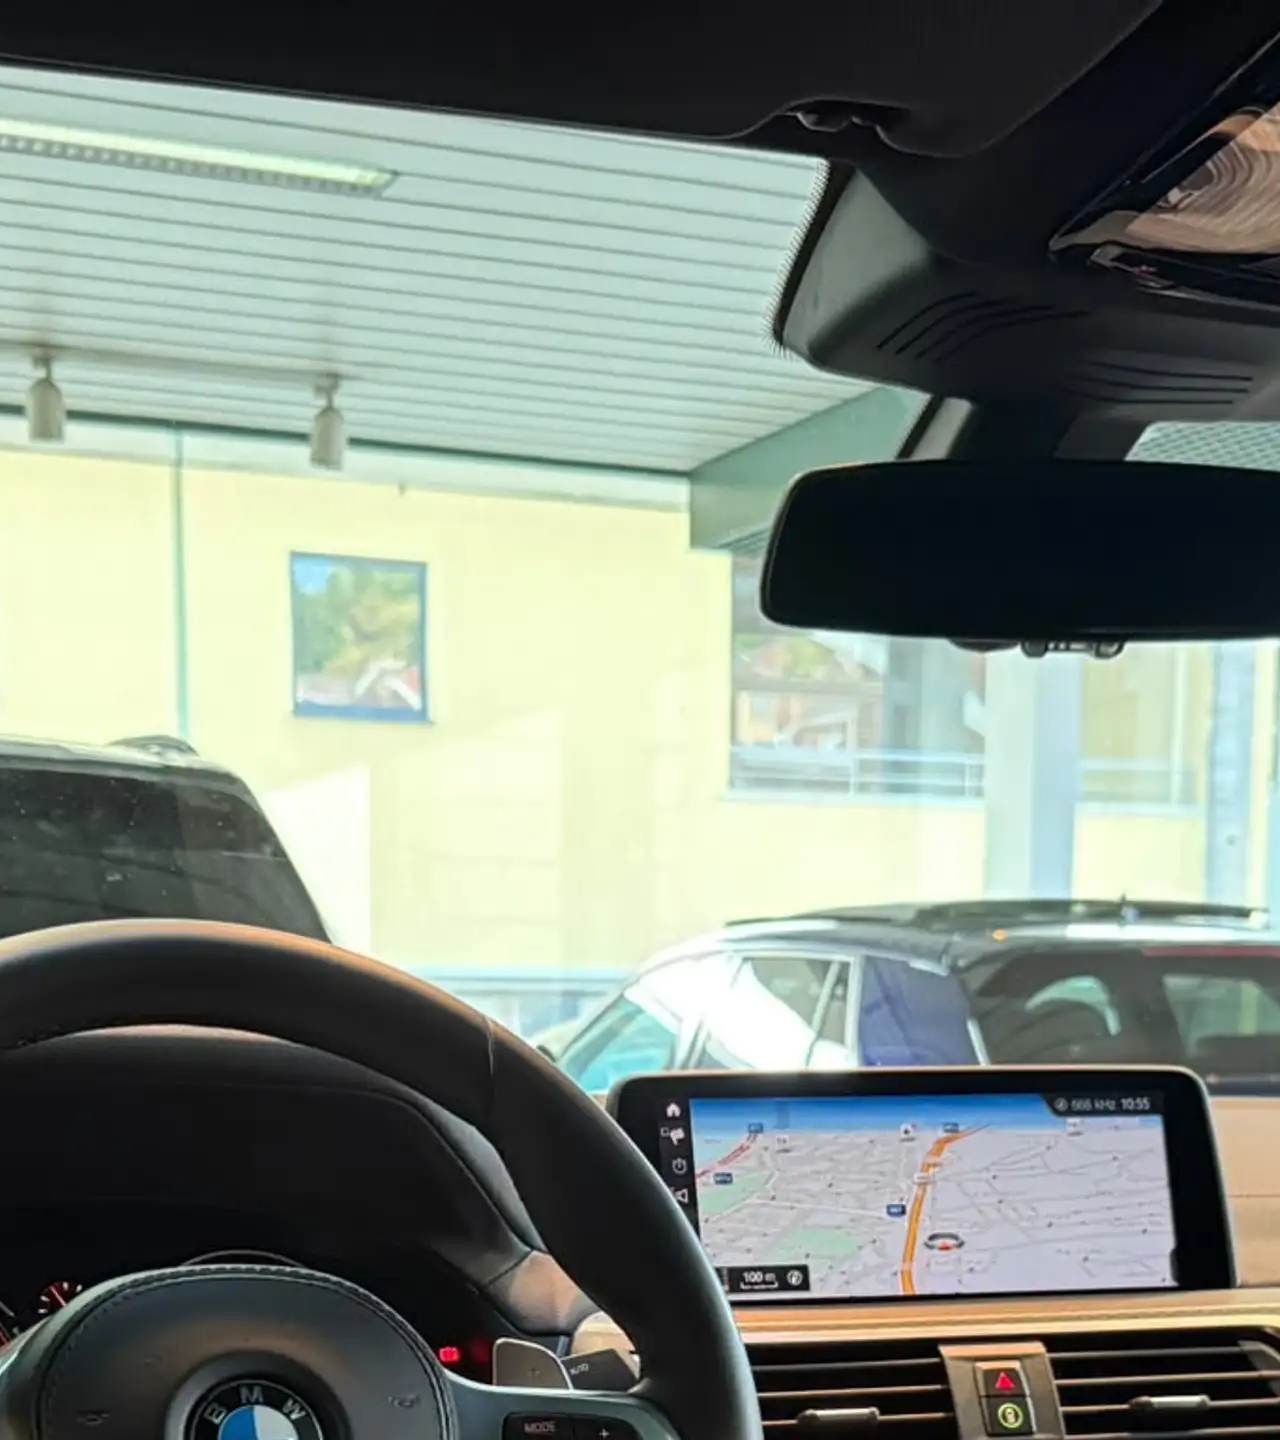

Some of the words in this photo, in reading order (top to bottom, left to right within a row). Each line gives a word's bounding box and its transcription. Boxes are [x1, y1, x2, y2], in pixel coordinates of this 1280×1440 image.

[742, 1271, 763, 1283] 100
[203, 1386, 306, 1425] BMW
[523, 1420, 556, 1433] MODE
